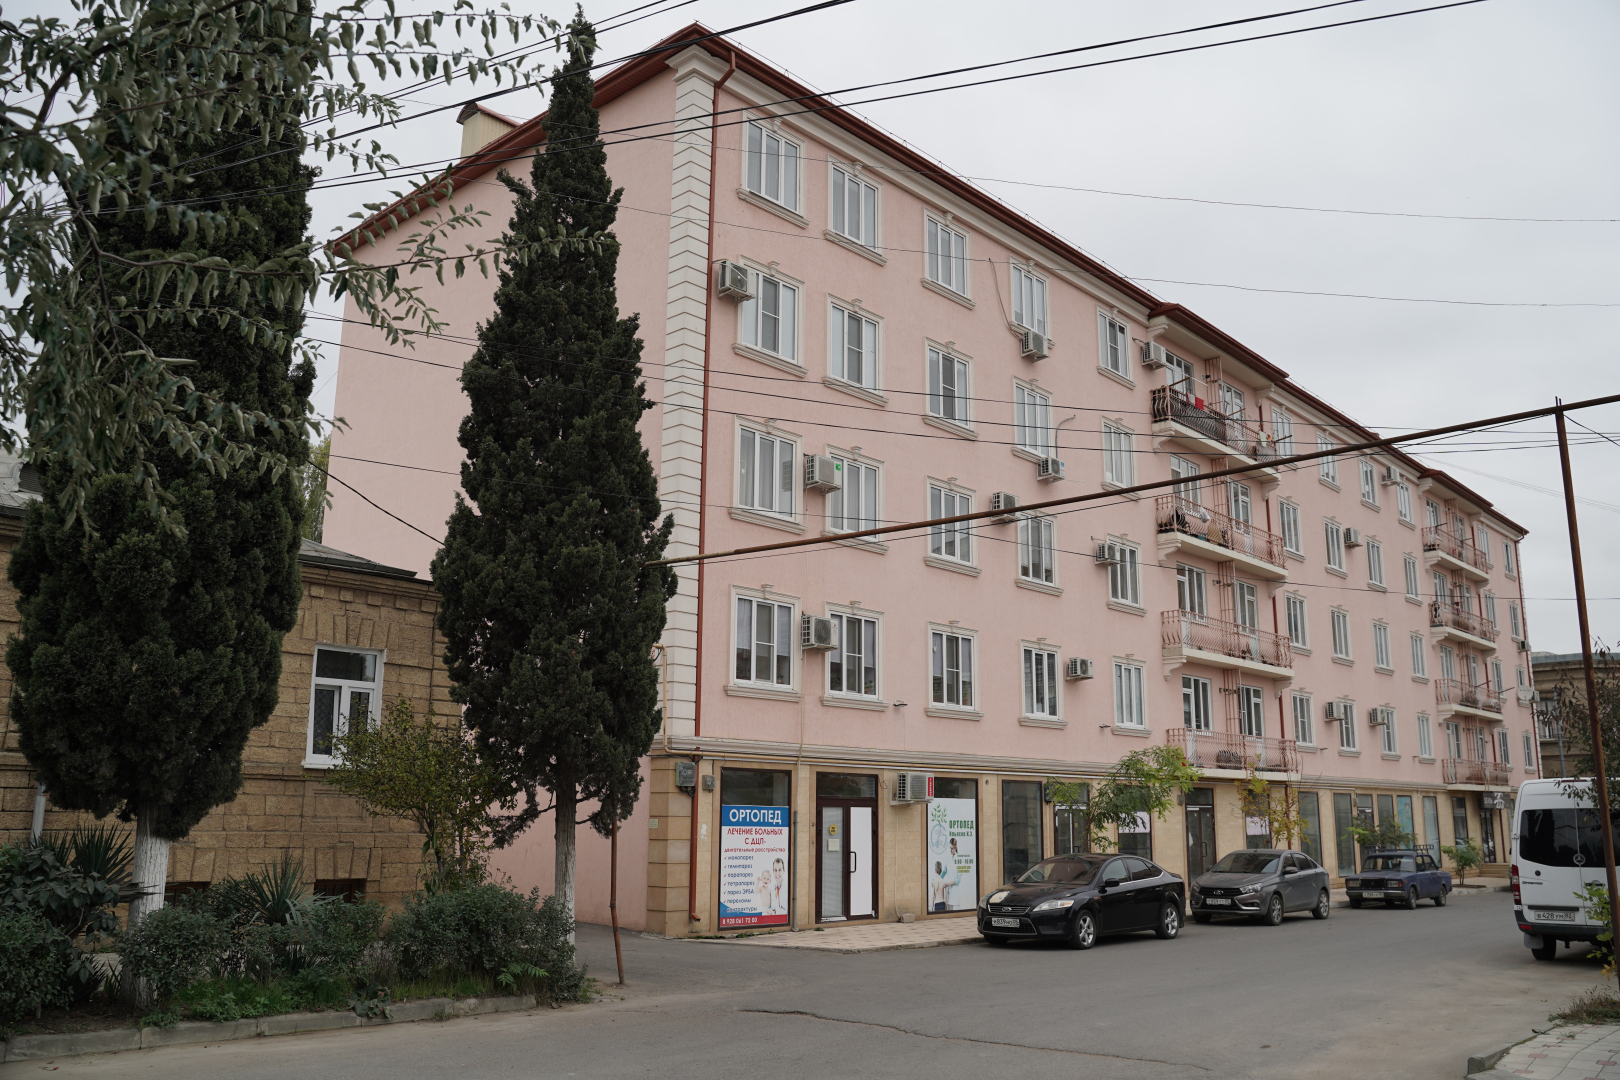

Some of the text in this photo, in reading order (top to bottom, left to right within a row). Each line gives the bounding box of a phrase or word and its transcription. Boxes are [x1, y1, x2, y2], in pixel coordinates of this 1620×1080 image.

[729, 809, 782, 825] ОРТОПЕД
[949, 820, 974, 830] ОРТОПЕД
[727, 828, 783, 836] ЛЕЧЕНИЕ БОЛЬНЫХ
